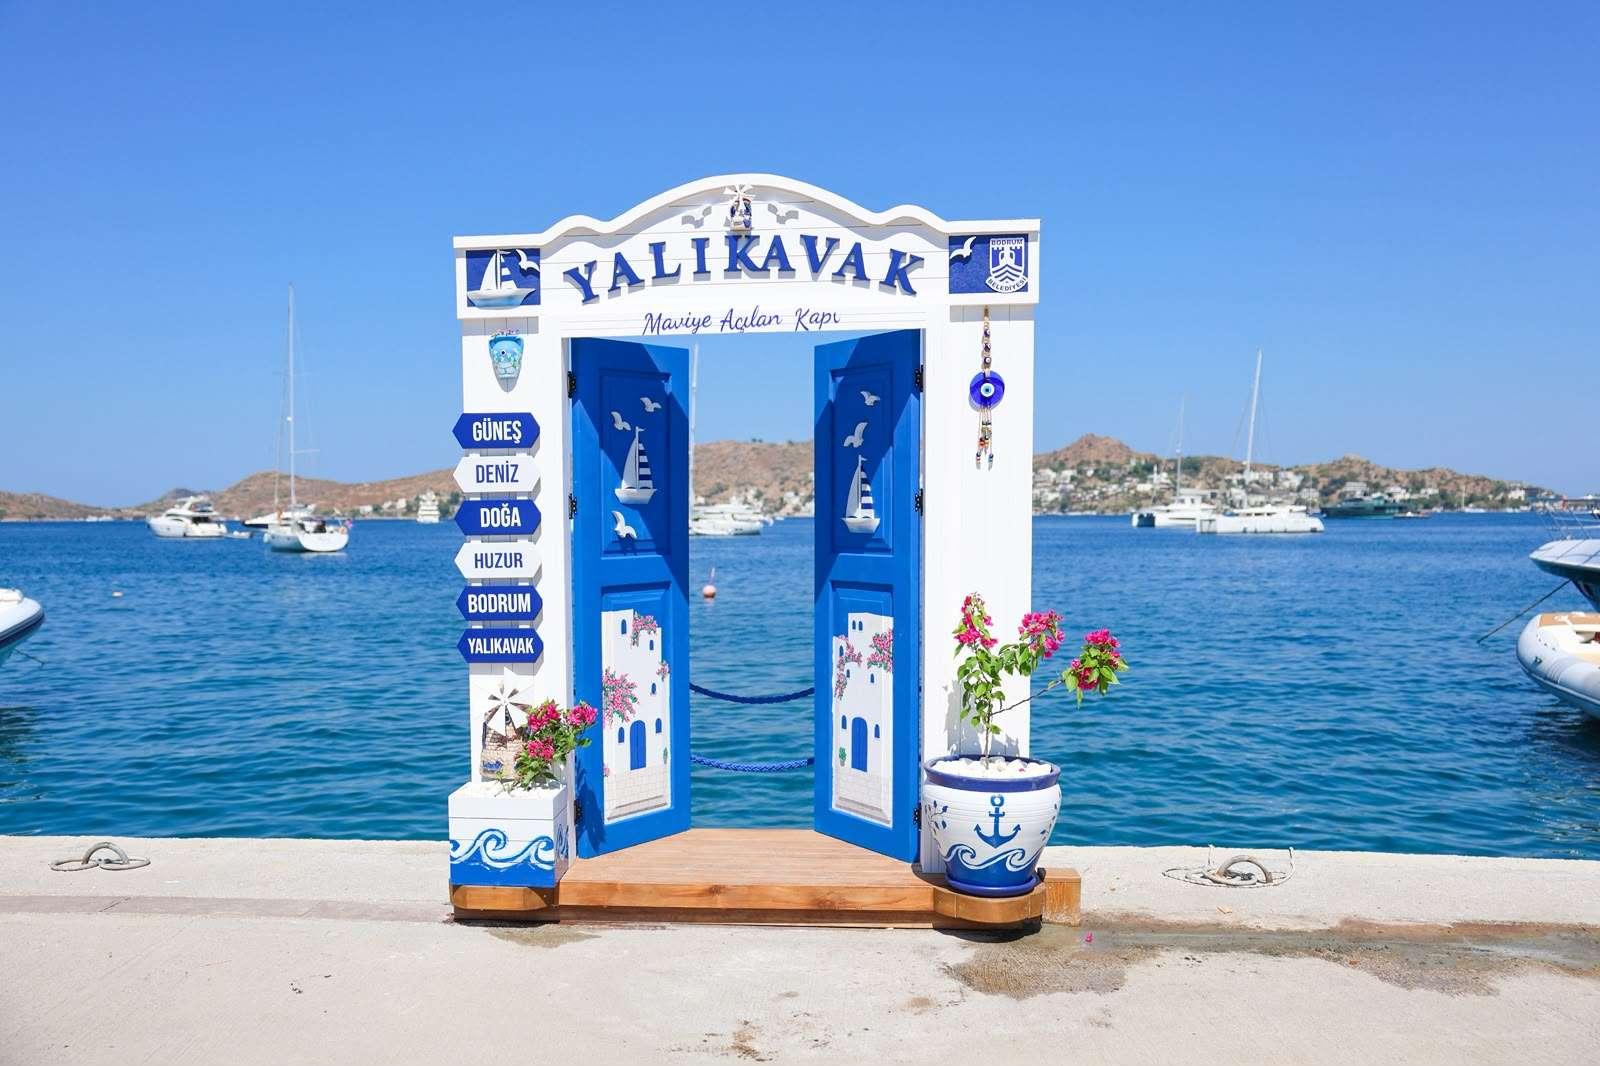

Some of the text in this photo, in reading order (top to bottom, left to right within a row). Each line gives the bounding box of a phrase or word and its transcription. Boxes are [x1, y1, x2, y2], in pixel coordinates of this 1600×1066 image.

[562, 235, 925, 303] YALIKAVAK
[642, 312, 712, 335] Maviye
[720, 306, 782, 333] Açılan
[472, 417, 522, 444] GÜNEŞ
[475, 460, 519, 483] DENİZ
[480, 502, 522, 528] DOĞA
[474, 552, 523, 569] HUZUR
[467, 593, 531, 613] BODRUM
[467, 637, 534, 654] YALIKAVAK
